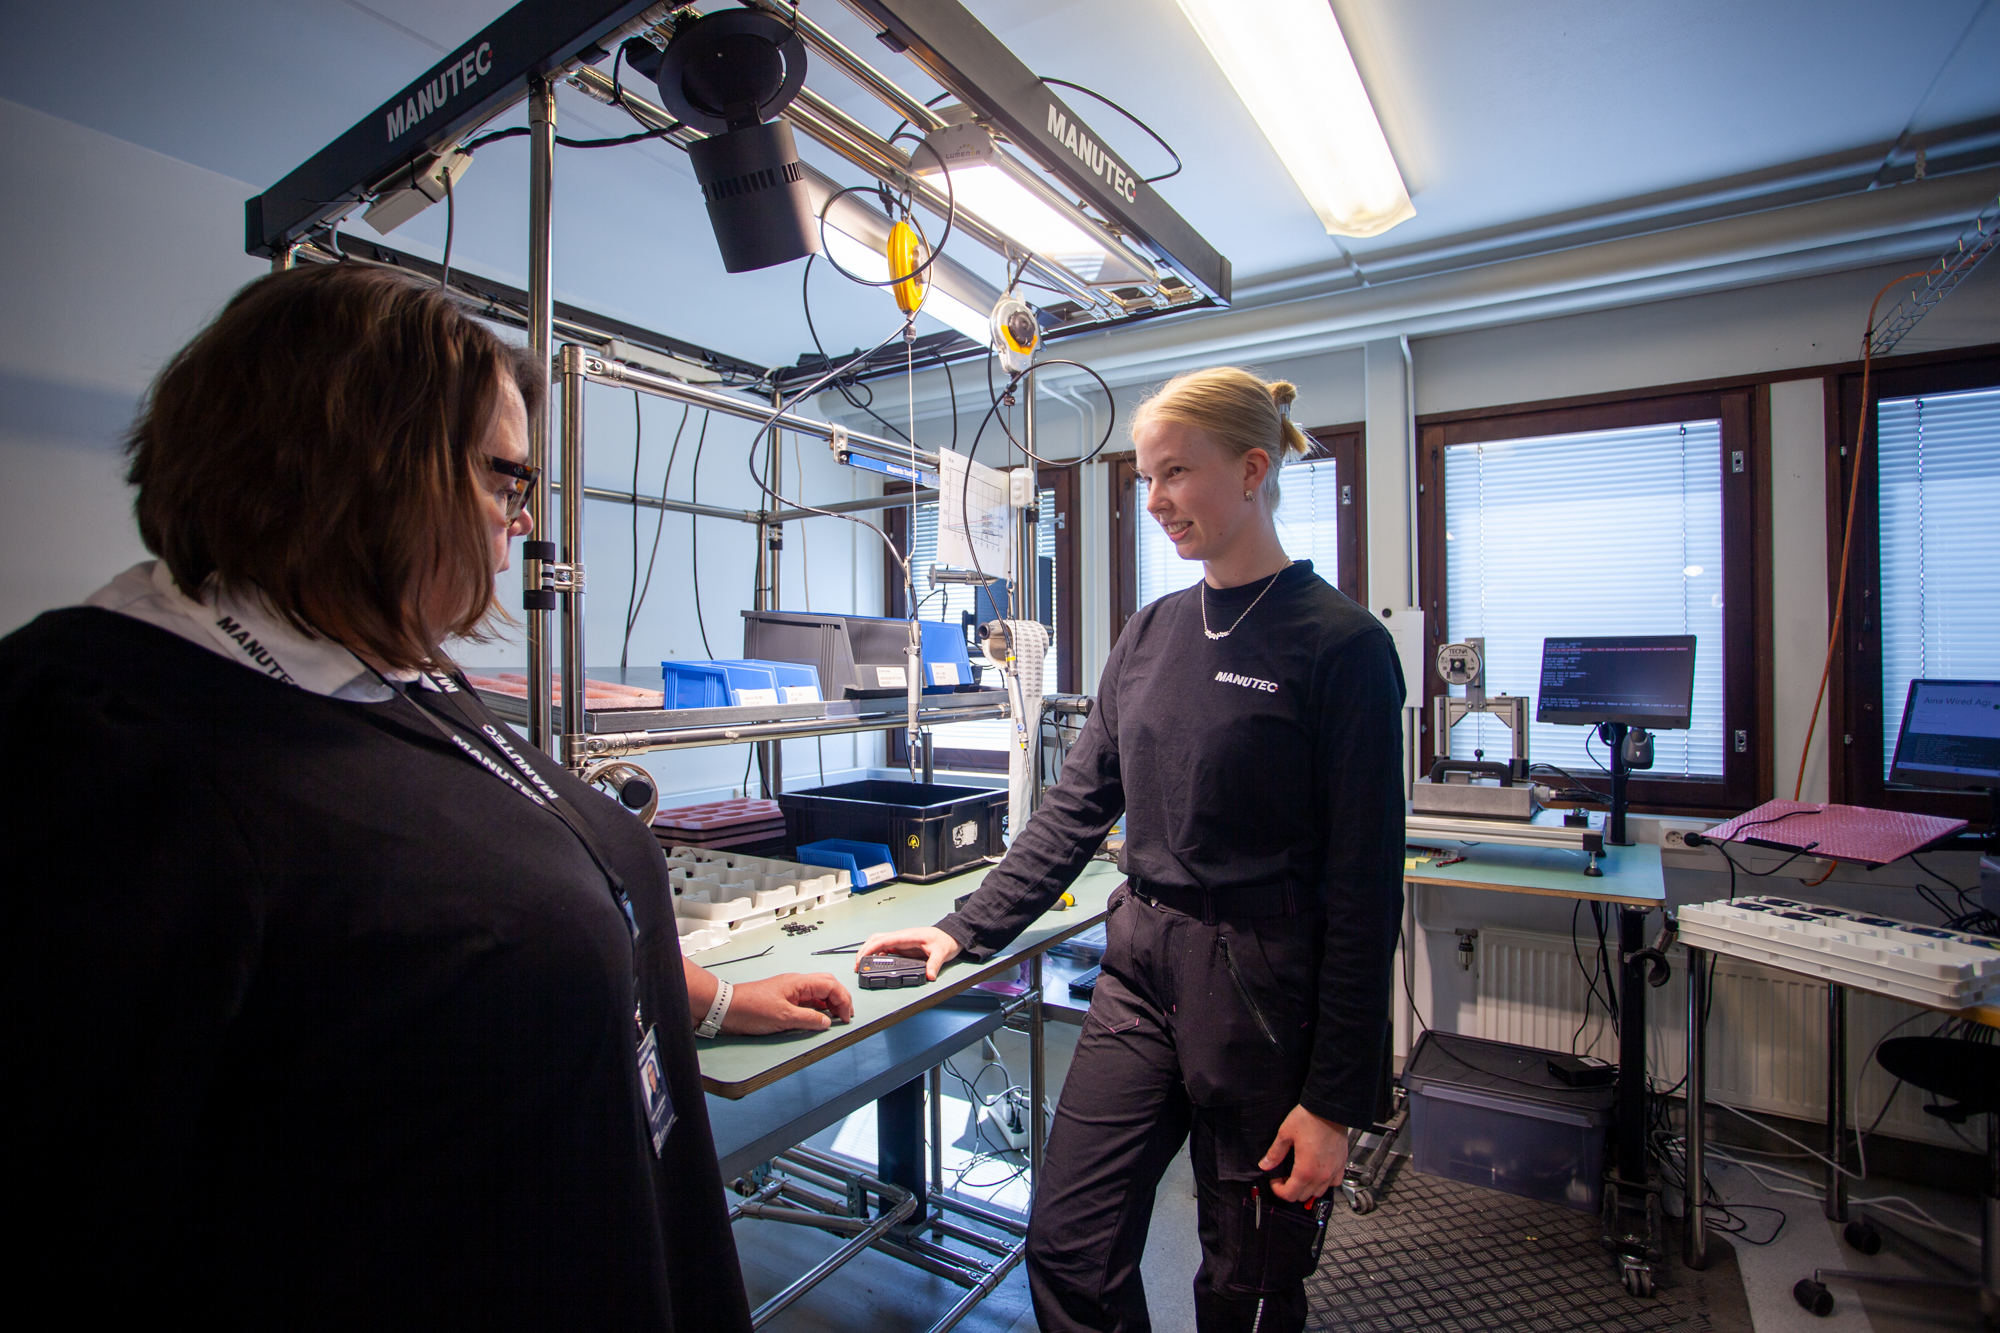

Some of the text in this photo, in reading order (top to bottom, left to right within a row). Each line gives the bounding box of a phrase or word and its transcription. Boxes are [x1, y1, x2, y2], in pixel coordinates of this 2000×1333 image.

[386, 41, 493, 143] MANUTEC
[1046, 103, 1137, 204] MANUTEC
[216, 616, 296, 686] MANUTE
[1214, 671, 1279, 693] MANUTEC
[452, 735, 545, 806] MANUTEC
[482, 724, 559, 799] MANUTEC
